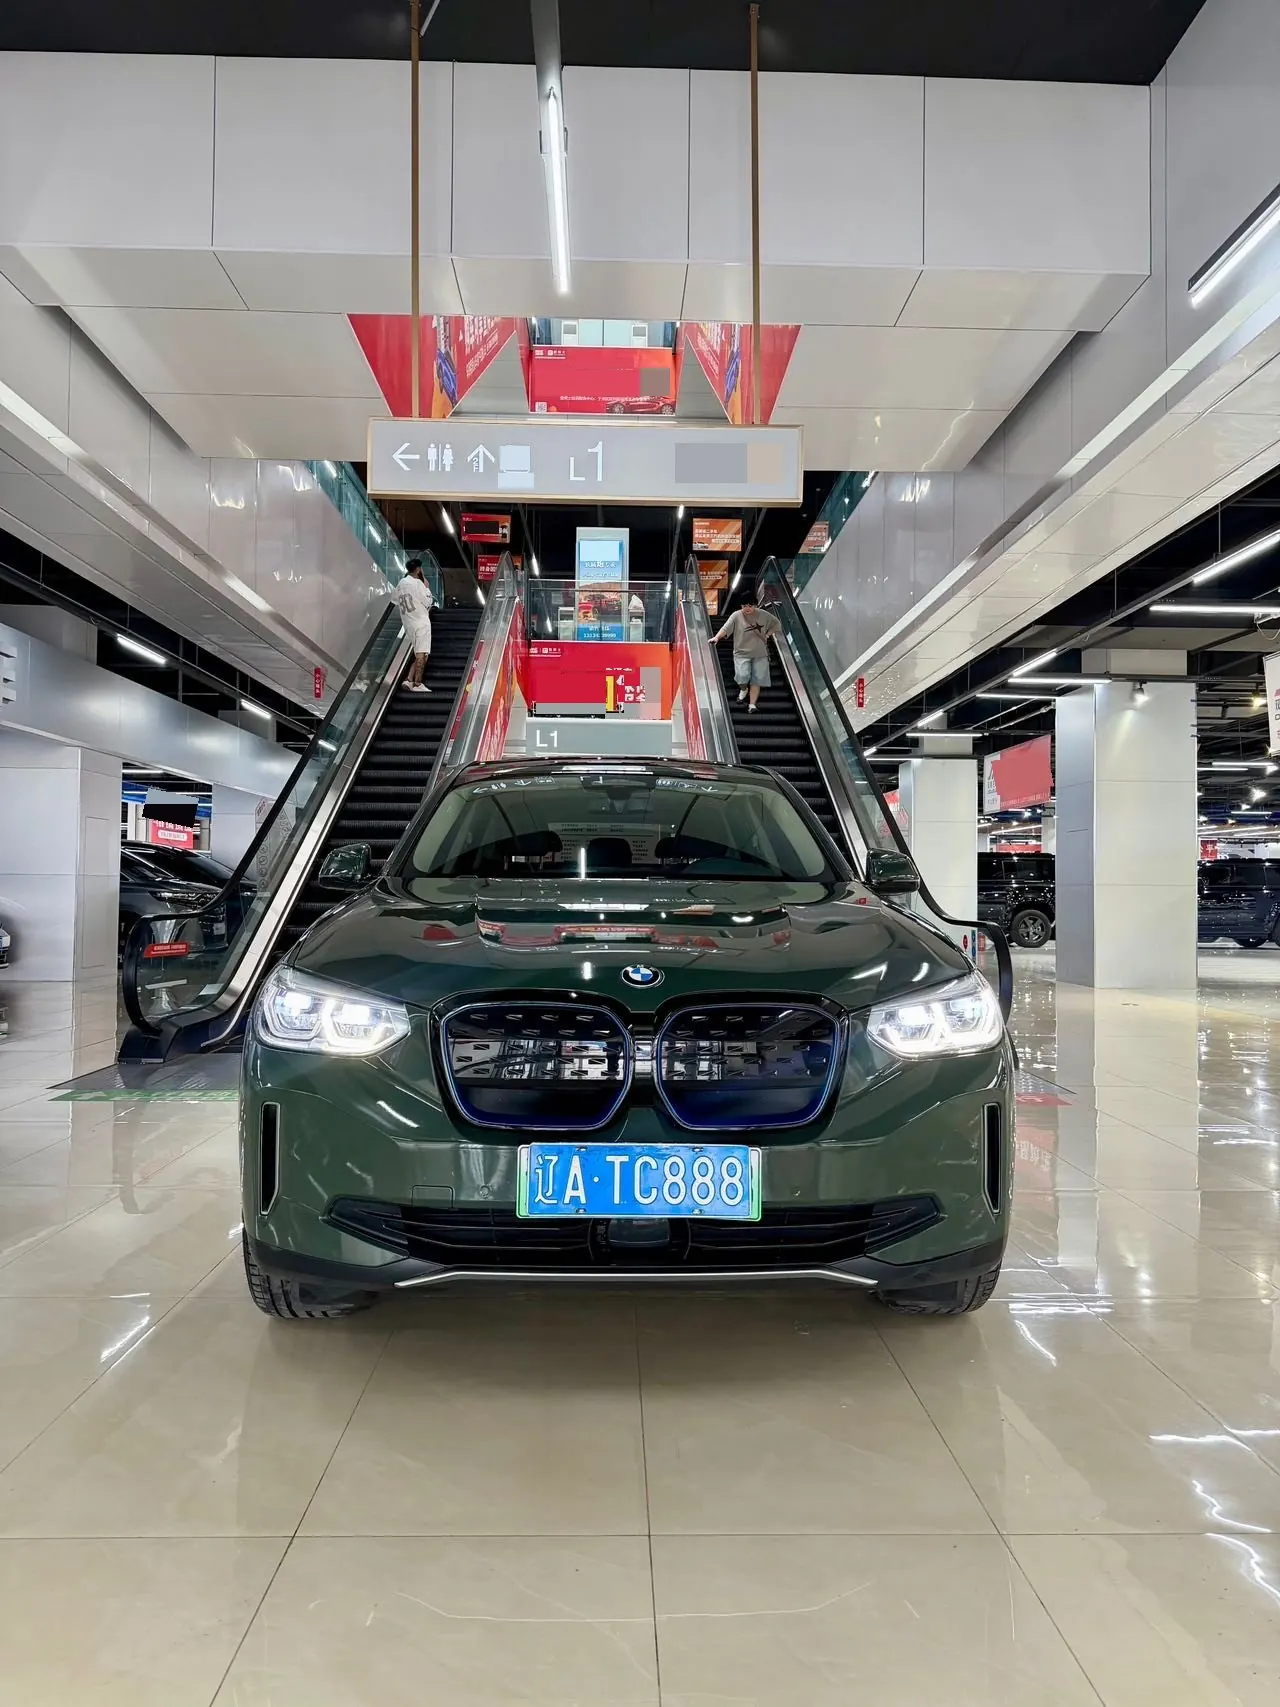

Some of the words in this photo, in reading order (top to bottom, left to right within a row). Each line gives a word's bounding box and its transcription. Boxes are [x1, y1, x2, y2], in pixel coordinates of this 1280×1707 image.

[569, 441, 603, 482] L1
[536, 729, 559, 748] L1
[534, 1153, 745, 1206] 辽A·TC888
